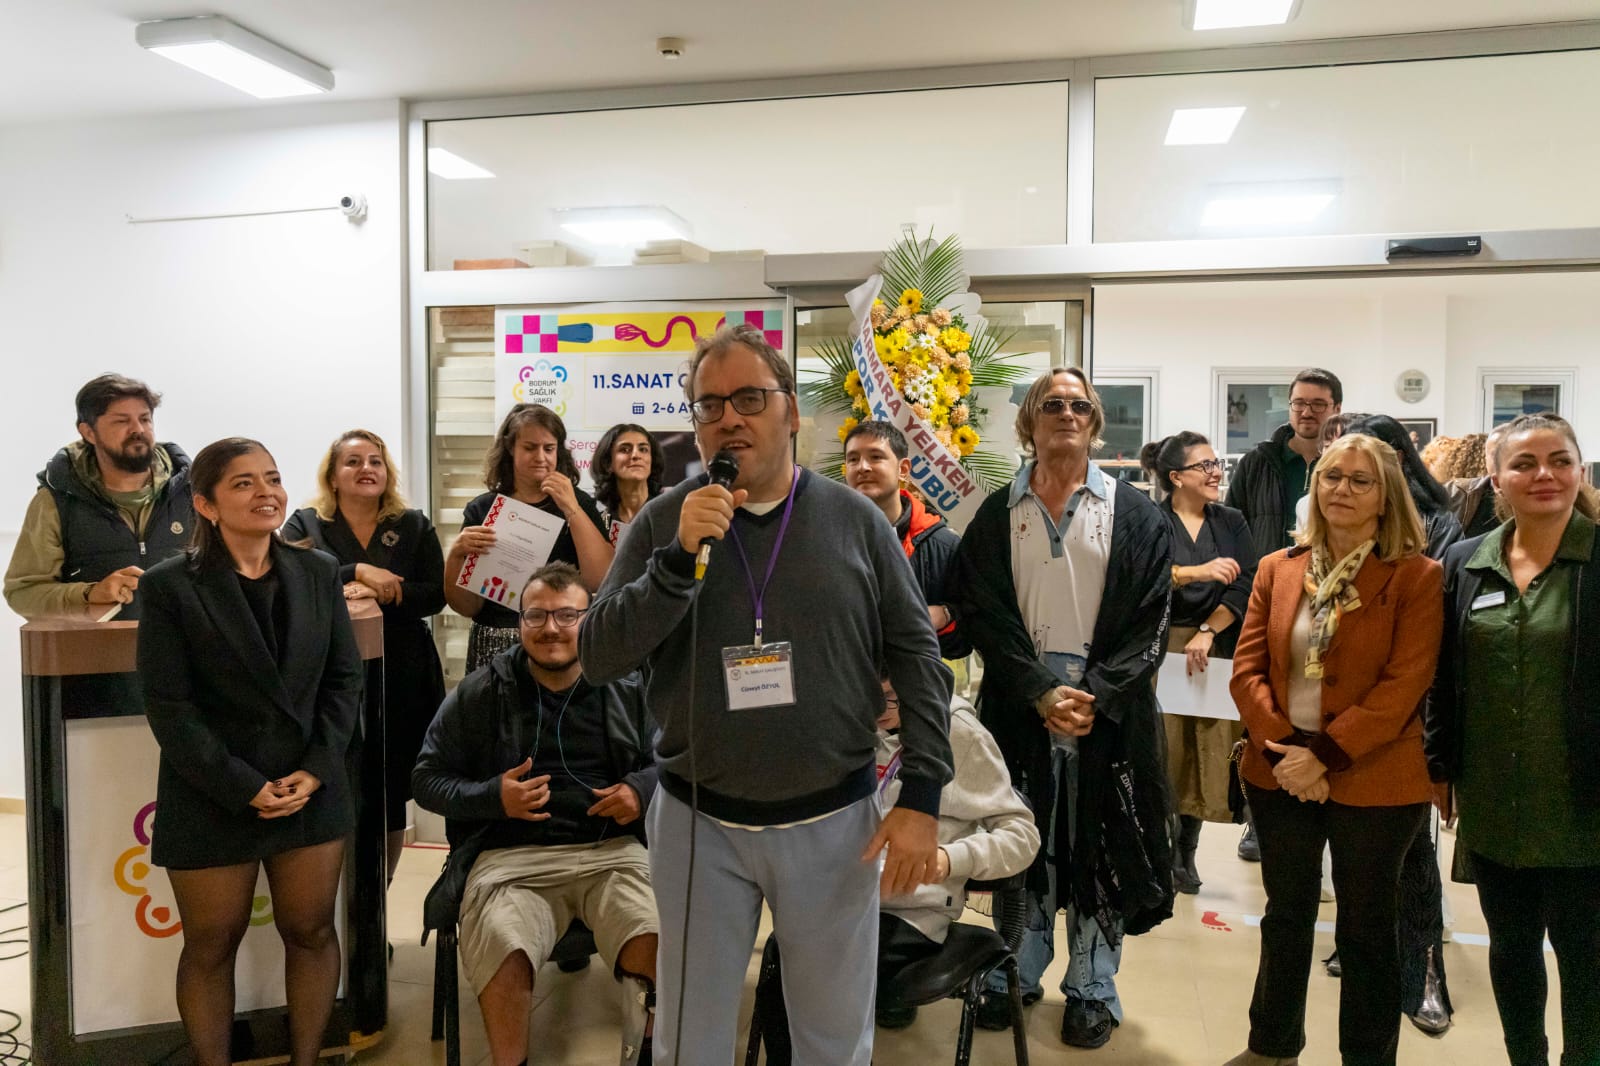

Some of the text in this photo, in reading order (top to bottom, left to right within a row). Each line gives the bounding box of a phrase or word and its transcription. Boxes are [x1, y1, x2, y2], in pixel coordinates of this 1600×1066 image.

[853, 339, 875, 399] POR
[592, 373, 674, 389] 11.SANAT
[528, 387, 557, 396] SAĞLIK
[652, 402, 675, 414] 2-6
[569, 439, 599, 453] Serg
[904, 415, 976, 498] YELKEN
